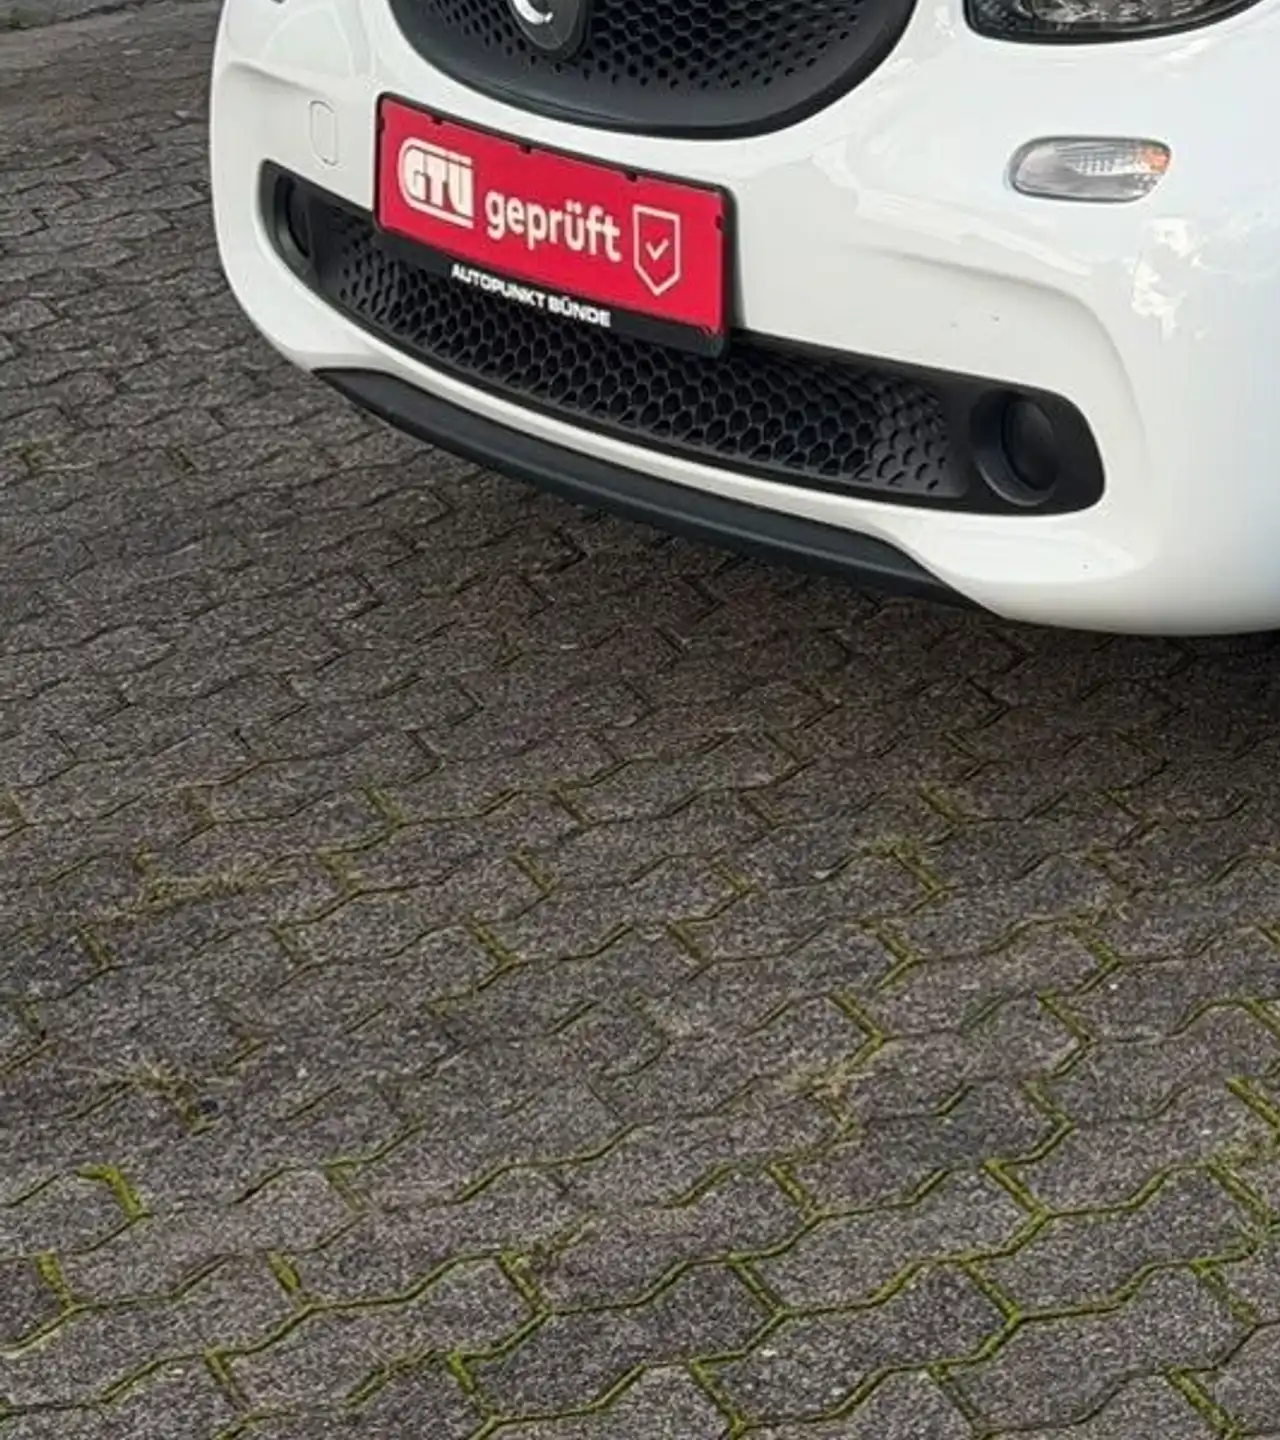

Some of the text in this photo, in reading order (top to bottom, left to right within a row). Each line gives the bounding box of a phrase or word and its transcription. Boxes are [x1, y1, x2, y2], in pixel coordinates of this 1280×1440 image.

[401, 144, 622, 262] GTÜ geprüft
[451, 263, 612, 328] AUTOPUNKT BÜNDE
